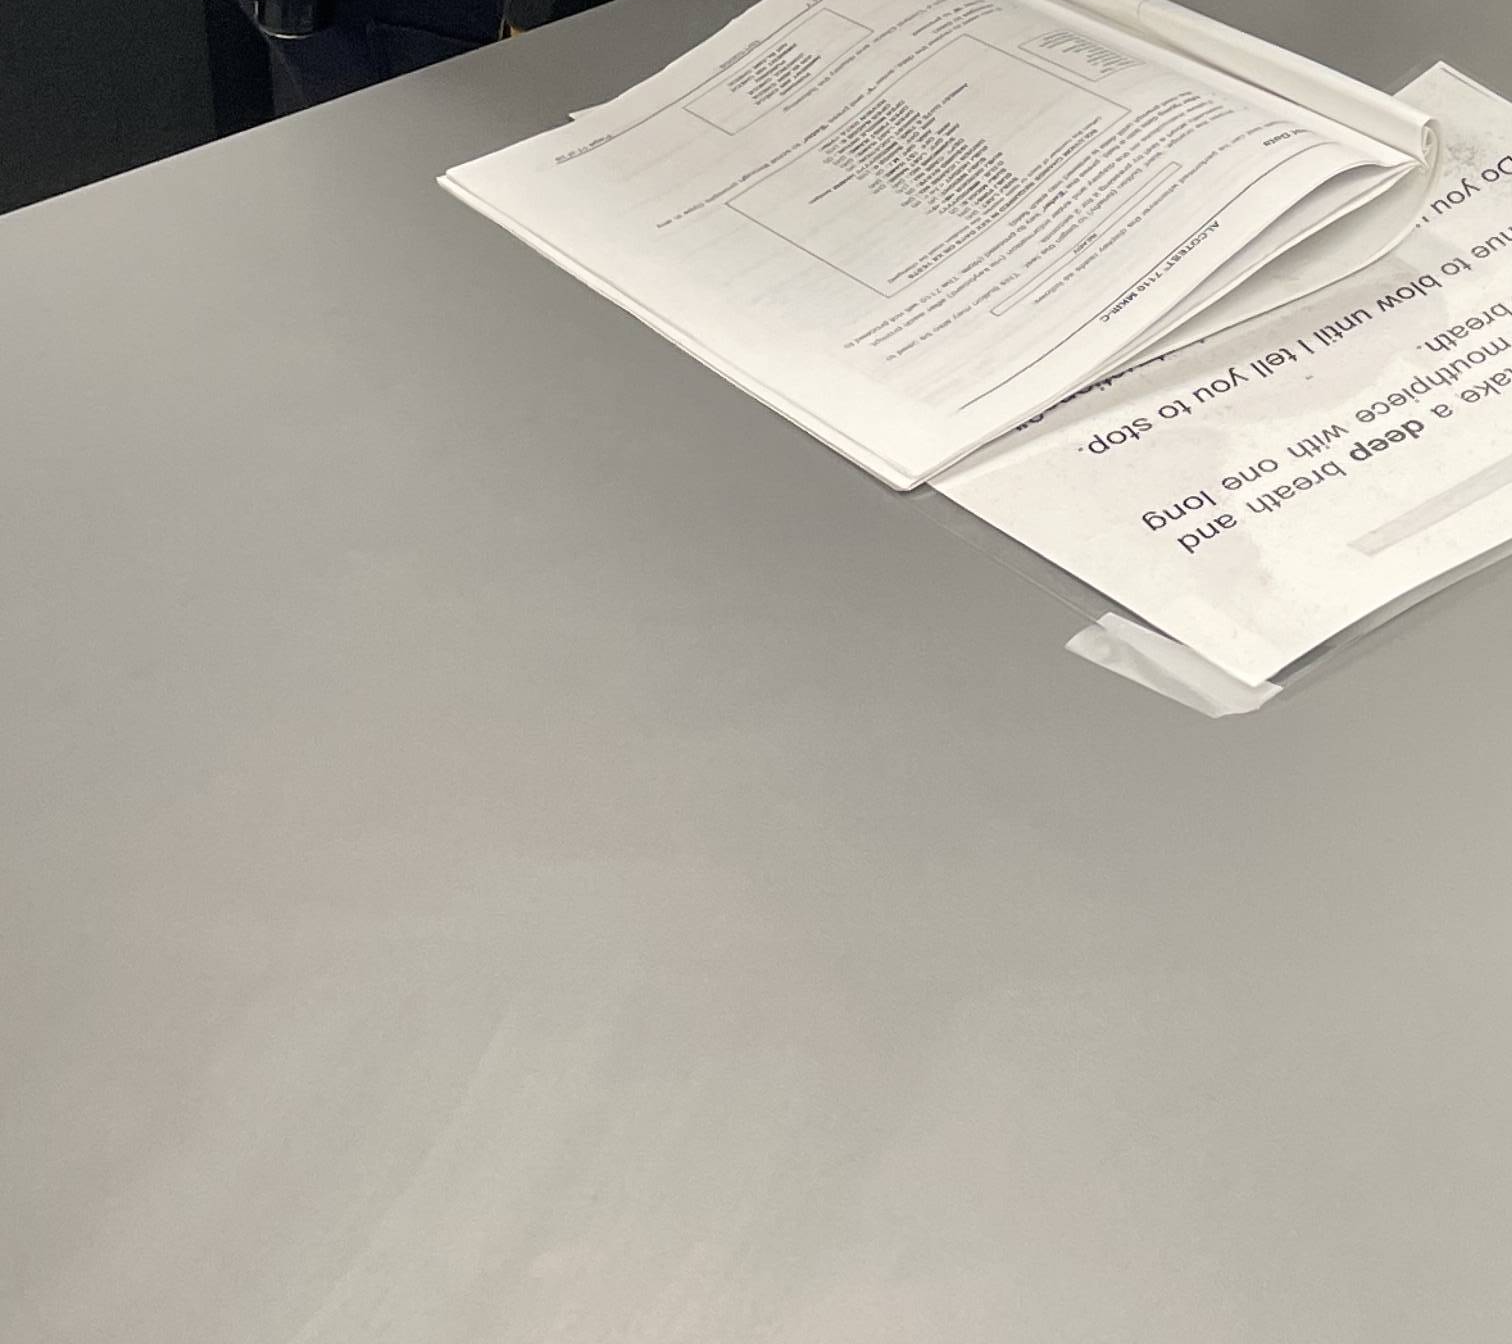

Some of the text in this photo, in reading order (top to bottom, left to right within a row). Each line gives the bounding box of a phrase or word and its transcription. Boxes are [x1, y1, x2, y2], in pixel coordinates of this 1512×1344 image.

[1429, 177, 1482, 215] you
[1440, 256, 1473, 276] to
[1375, 273, 1444, 313] blow
[1296, 338, 1316, 355] I
[1312, 308, 1374, 347] until
[1249, 347, 1298, 379] tell
[1354, 336, 1512, 424] mouthpiece
[1191, 366, 1250, 404] you
[1157, 399, 1193, 420] to
[1429, 403, 1454, 419] a
[1077, 416, 1154, 455] stop.
[1286, 423, 1350, 459] with
[1348, 418, 1425, 462] deep
[1220, 458, 1279, 491] one
[1245, 460, 1348, 514] breath
[1141, 489, 1218, 532] long
[1176, 513, 1239, 555] and
